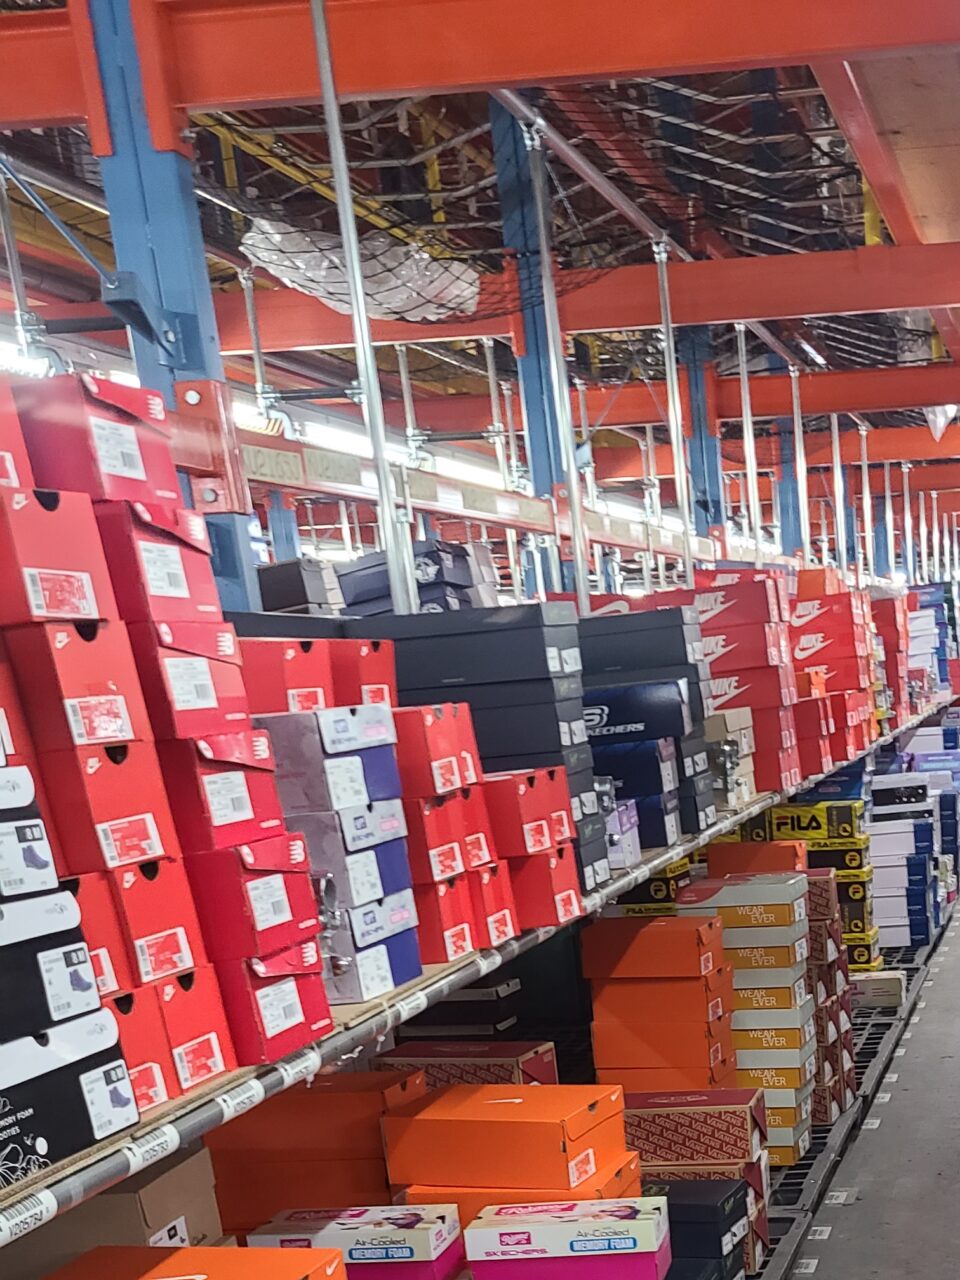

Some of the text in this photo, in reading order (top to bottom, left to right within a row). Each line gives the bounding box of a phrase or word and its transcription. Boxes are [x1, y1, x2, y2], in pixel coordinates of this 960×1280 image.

[588, 722, 645, 736] KECHERS
[776, 814, 822, 832] FILA
[736, 906, 765, 917] WEAR
[751, 914, 776, 924] EVER
[737, 949, 765, 958] WEAR
[751, 956, 776, 966] EVER
[738, 989, 767, 999] WEAR
[752, 996, 777, 1007] EVER
[750, 1029, 777, 1039] WEAR
[763, 1037, 787, 1047] EVER
[750, 1069, 777, 1079] WEAR
[763, 1077, 788, 1086] EVER
[0, 1126, 22, 1142] OOTIES
[576, 1227, 630, 1238] Air-Cooled
[354, 1237, 407, 1247] Air-Cooled
[572, 1237, 635, 1252] MEMORY FOAM
[350, 1248, 411, 1260] MEMORY FOAM
